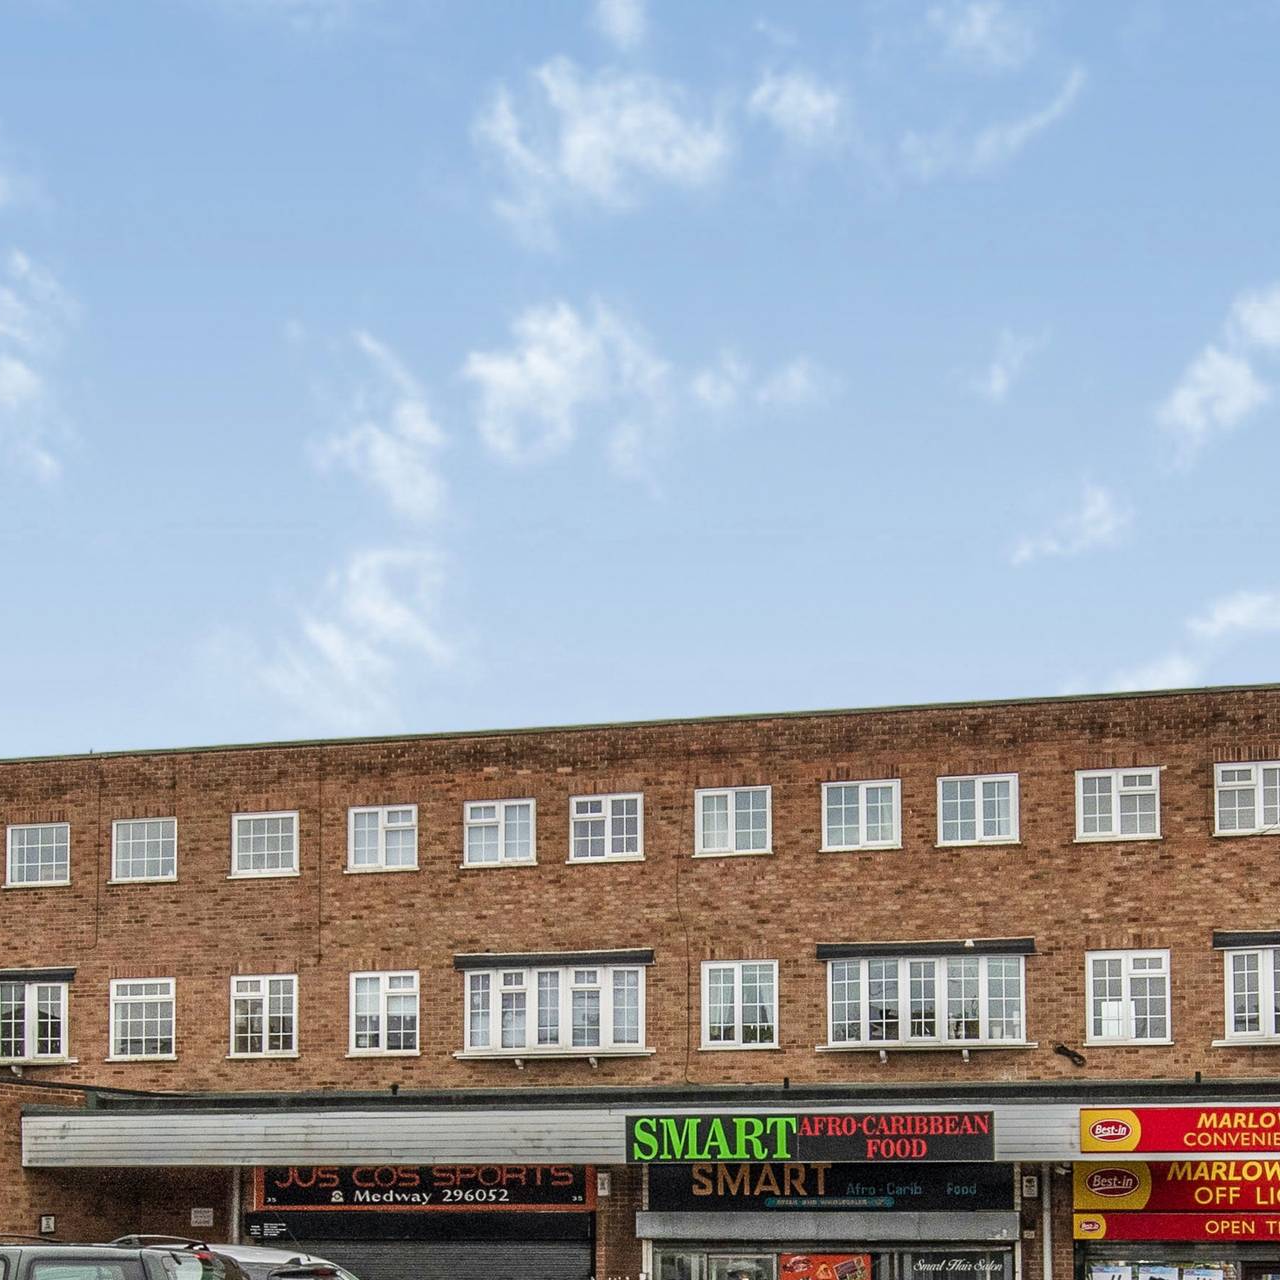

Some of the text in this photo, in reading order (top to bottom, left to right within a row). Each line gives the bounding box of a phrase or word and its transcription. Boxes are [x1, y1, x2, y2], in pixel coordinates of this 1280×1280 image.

[633, 1116, 797, 1161] SMART
[866, 1139, 927, 1159] FOOD
[274, 1165, 574, 1188] JUS COS SPORTS
[691, 1163, 832, 1197] SMART
[354, 1189, 510, 1205] Medway 296052
[846, 1182, 876, 1195] Afro
[886, 1182, 922, 1195] Carib
[946, 1182, 977, 1195] Food
[1194, 1187, 1240, 1205] OFF
[1205, 1220, 1255, 1234] OPEN
[913, 1258, 1003, 1271] Smart Hair Salon
